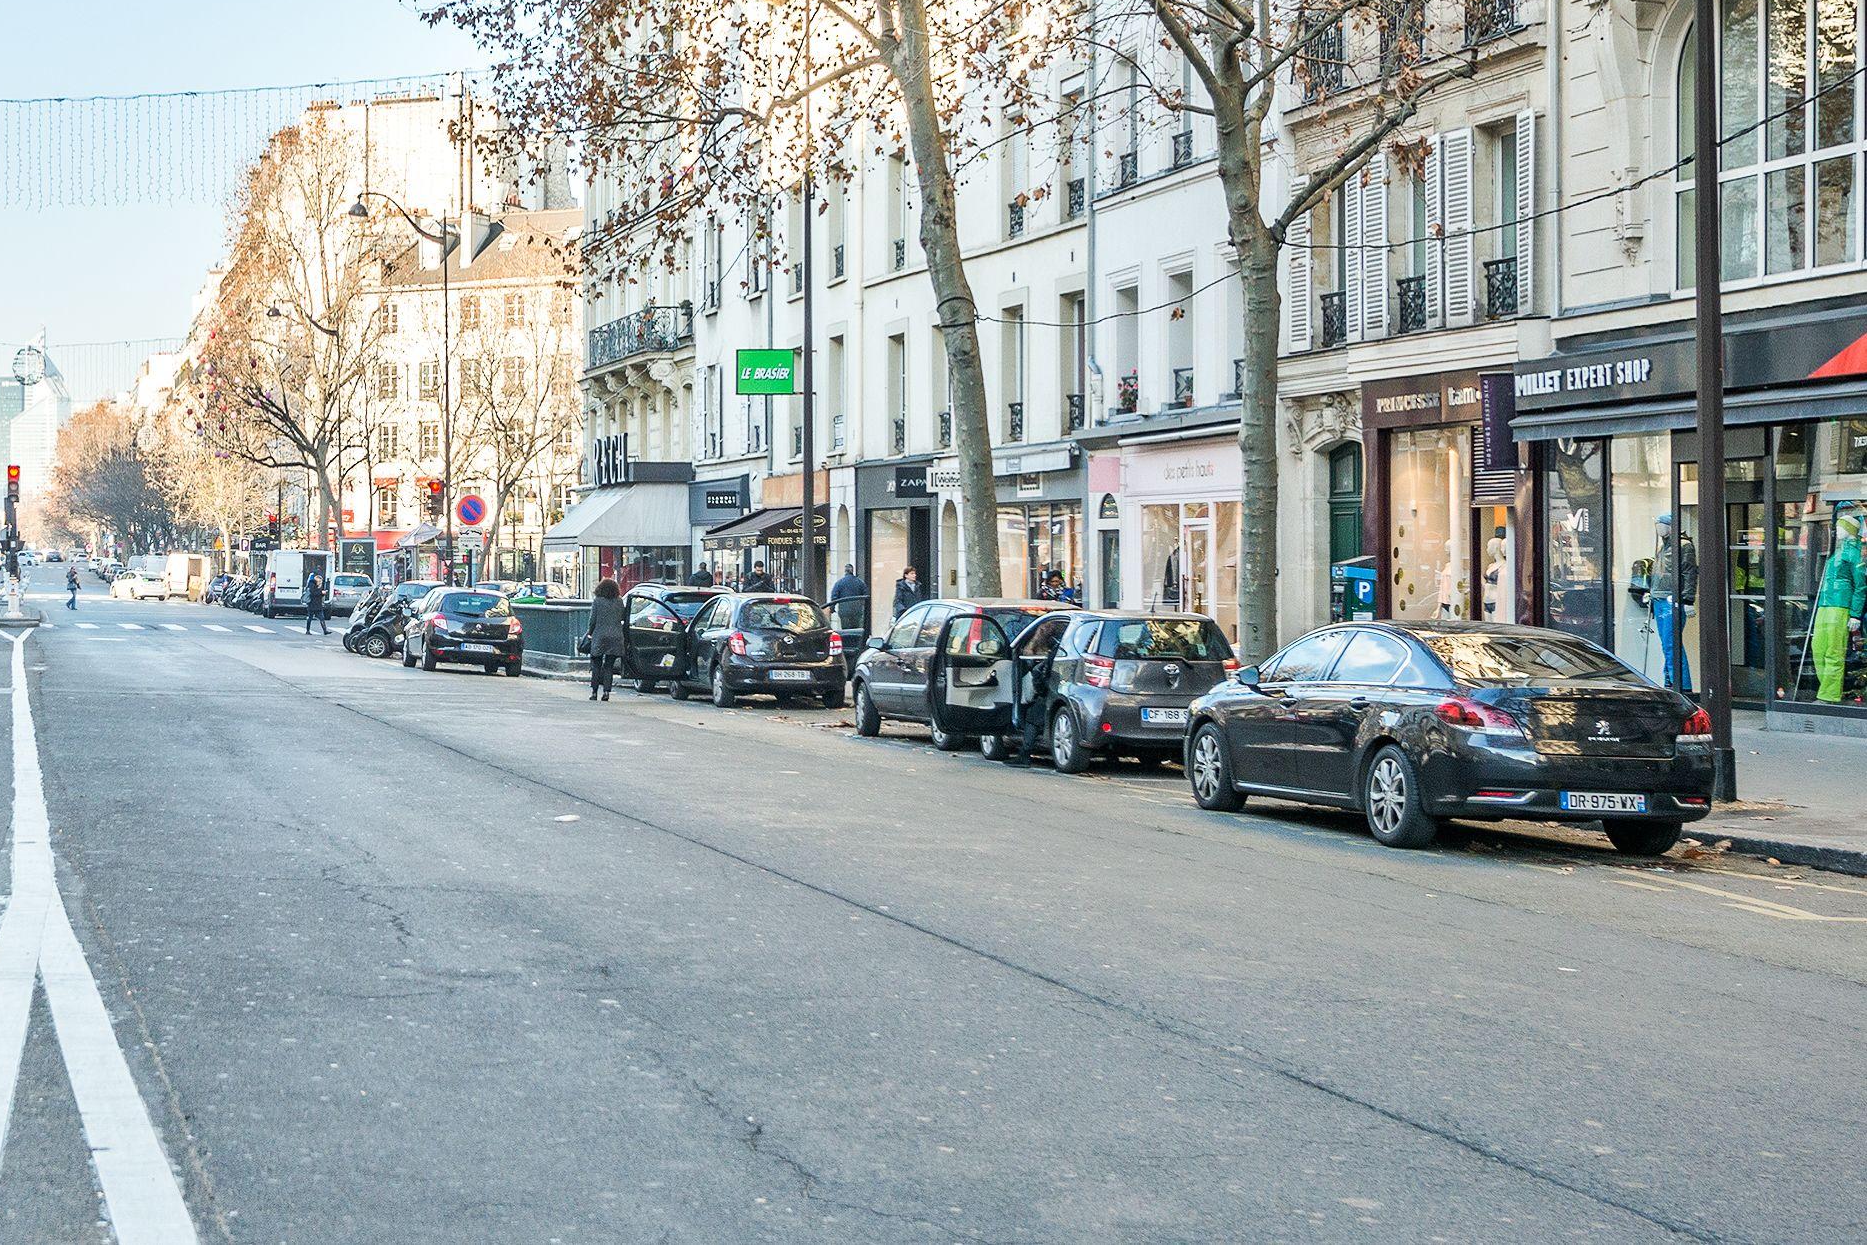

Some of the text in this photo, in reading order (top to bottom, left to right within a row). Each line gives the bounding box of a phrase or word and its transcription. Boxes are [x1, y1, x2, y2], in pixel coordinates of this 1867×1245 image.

[741, 367, 752, 380] LE
[1515, 358, 1651, 397] MILLET EXPERT SHOP
[1359, 581, 1371, 600] P
[1569, 795, 1637, 811] DR-975-WX
